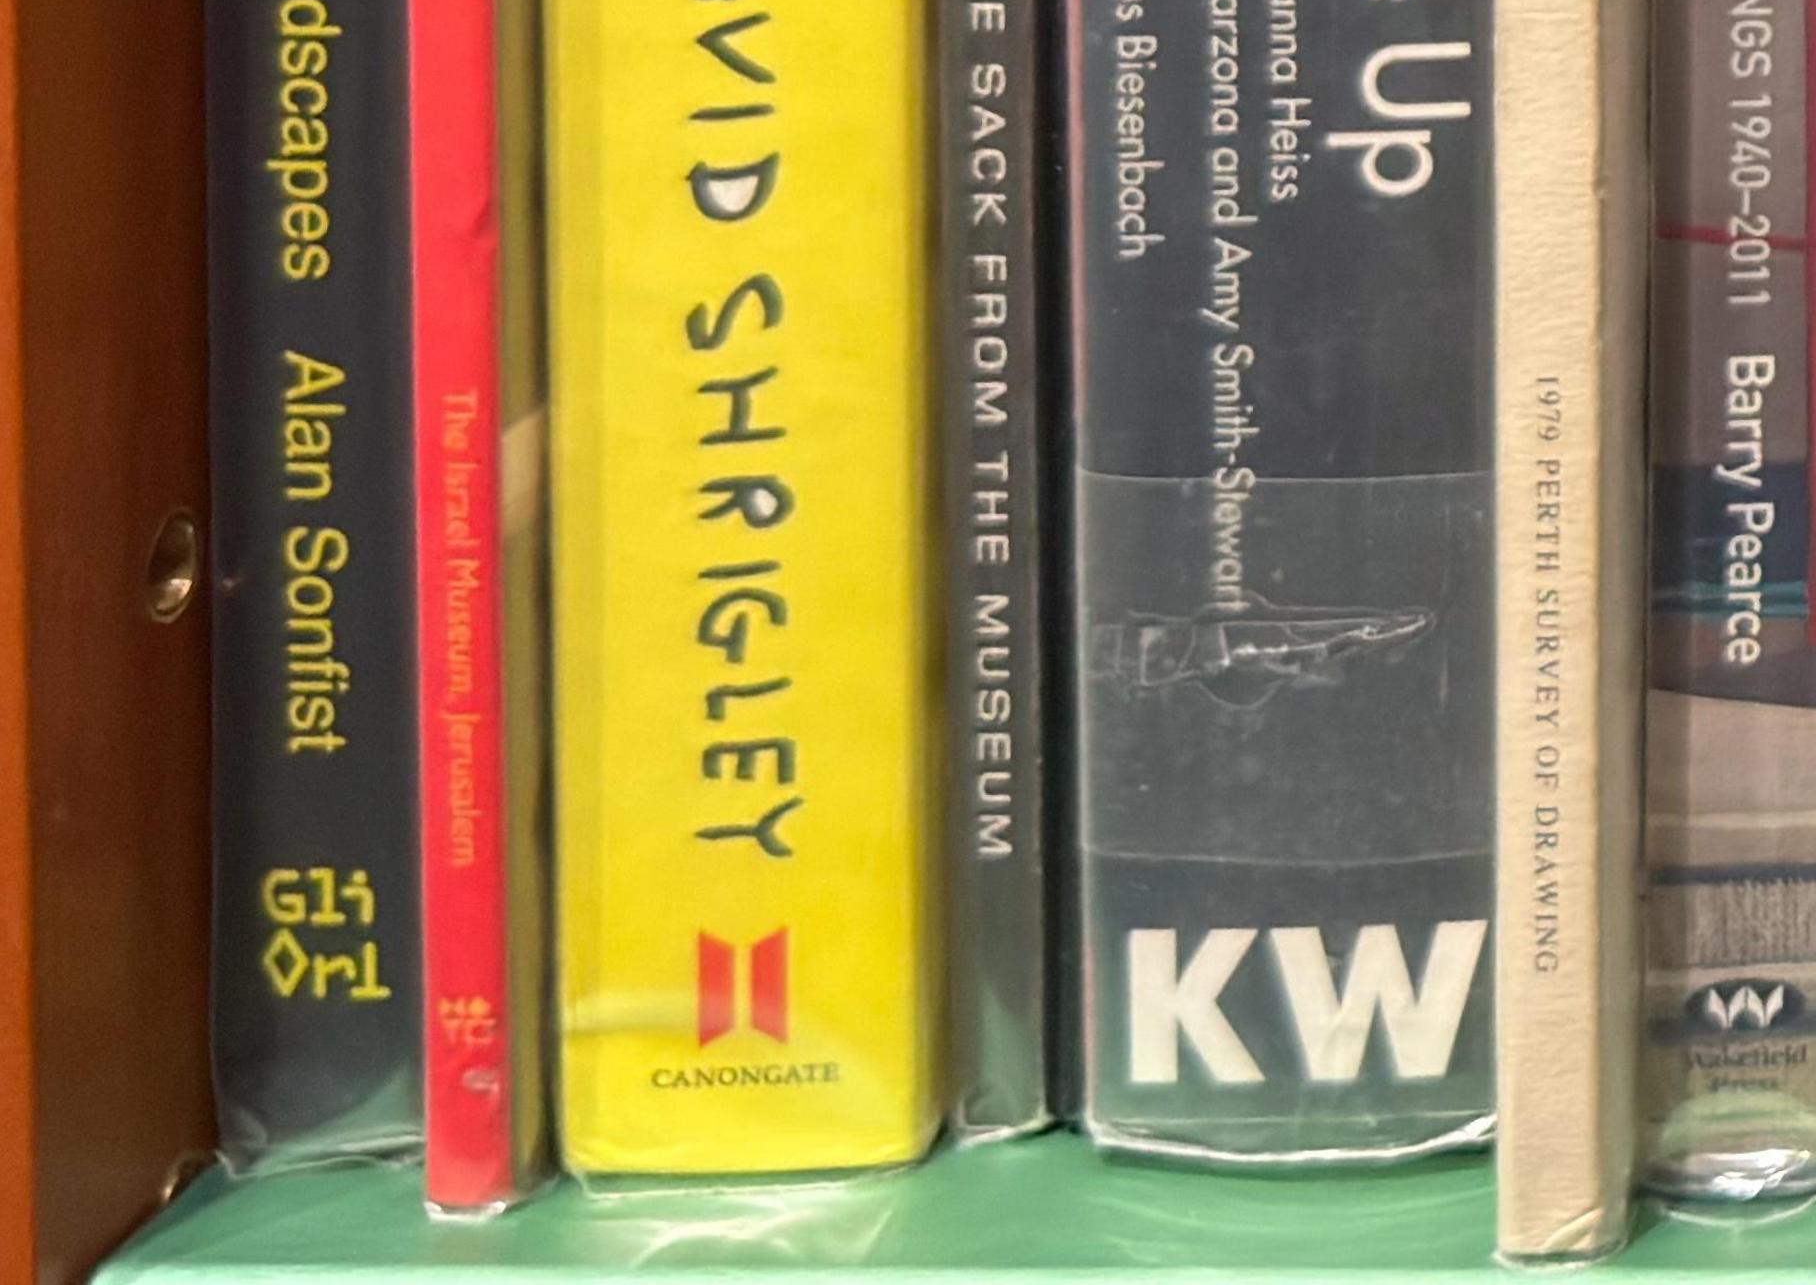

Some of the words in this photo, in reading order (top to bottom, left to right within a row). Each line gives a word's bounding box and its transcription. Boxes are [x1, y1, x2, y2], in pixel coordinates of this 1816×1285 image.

[970, 62, 1005, 225] SACK
[1118, 33, 1160, 258] Biesenbach
[1268, 98, 1312, 202] Heiss
[1325, 40, 1472, 195] Up
[970, 252, 1007, 425] FROM
[1203, 235, 1252, 330] Amy
[285, 350, 346, 498] Alan
[1715, 352, 1778, 487] Barry
[685, 275, 803, 857] SHRIGLEY
[972, 450, 1008, 563] THE
[1725, 500, 1775, 668] Pearce
[285, 527, 350, 752] Sonfist
[973, 593, 1012, 858] MUSEUM
[1128, 920, 1490, 1082] KW
